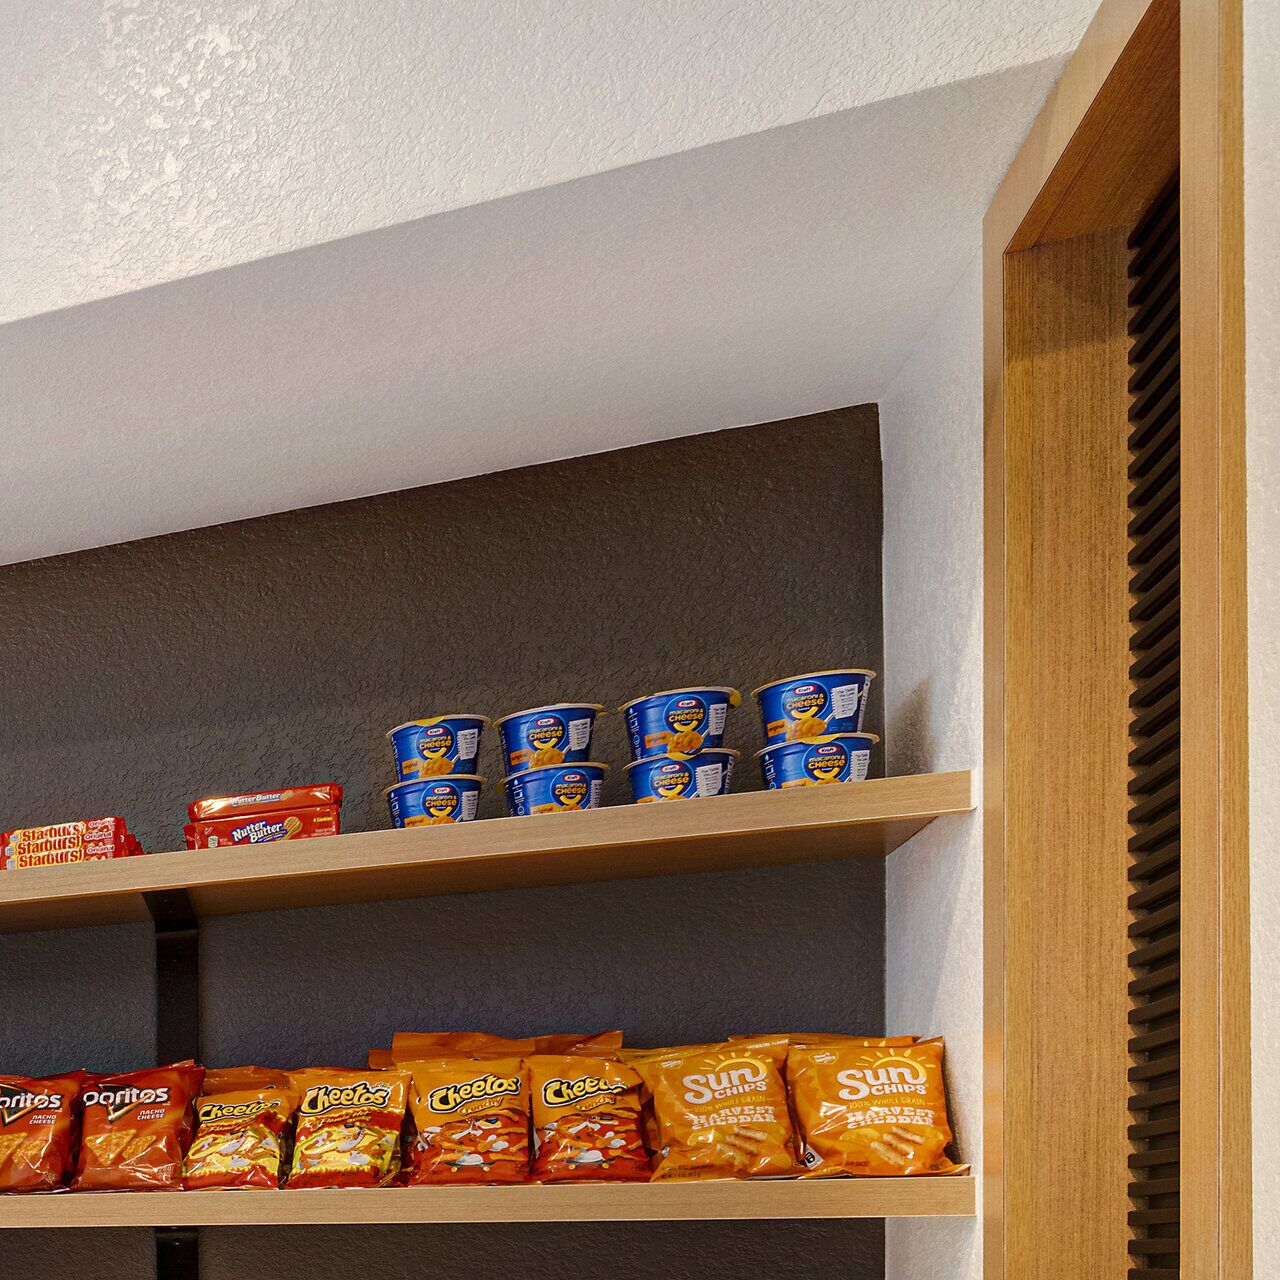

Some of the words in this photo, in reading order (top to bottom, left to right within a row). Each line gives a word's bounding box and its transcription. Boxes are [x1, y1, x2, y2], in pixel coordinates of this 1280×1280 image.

[232, 820, 268, 842] Nutter
[249, 823, 283, 843] Butter
[683, 1067, 768, 1104] Sun
[715, 1082, 768, 1098] CHIPS
[837, 1066, 927, 1100] Sun
[871, 1083, 927, 1095] CHIPS
[83, 1087, 169, 1107] Doritos
[302, 1082, 389, 1115] Cheetos
[430, 1075, 519, 1111] Cheetos
[715, 1099, 740, 1108] WHOLE
[741, 1095, 766, 1104] GRAIN
[871, 1097, 898, 1105] WHOLE
[900, 1098, 926, 1106] GRAIN
[199, 1100, 278, 1121] Cheetos
[691, 1106, 775, 1124] HARVEST
[846, 1107, 934, 1124] HARVEST
[691, 1115, 777, 1130] CHEDDAR
[847, 1115, 934, 1129] CHEDDAR
